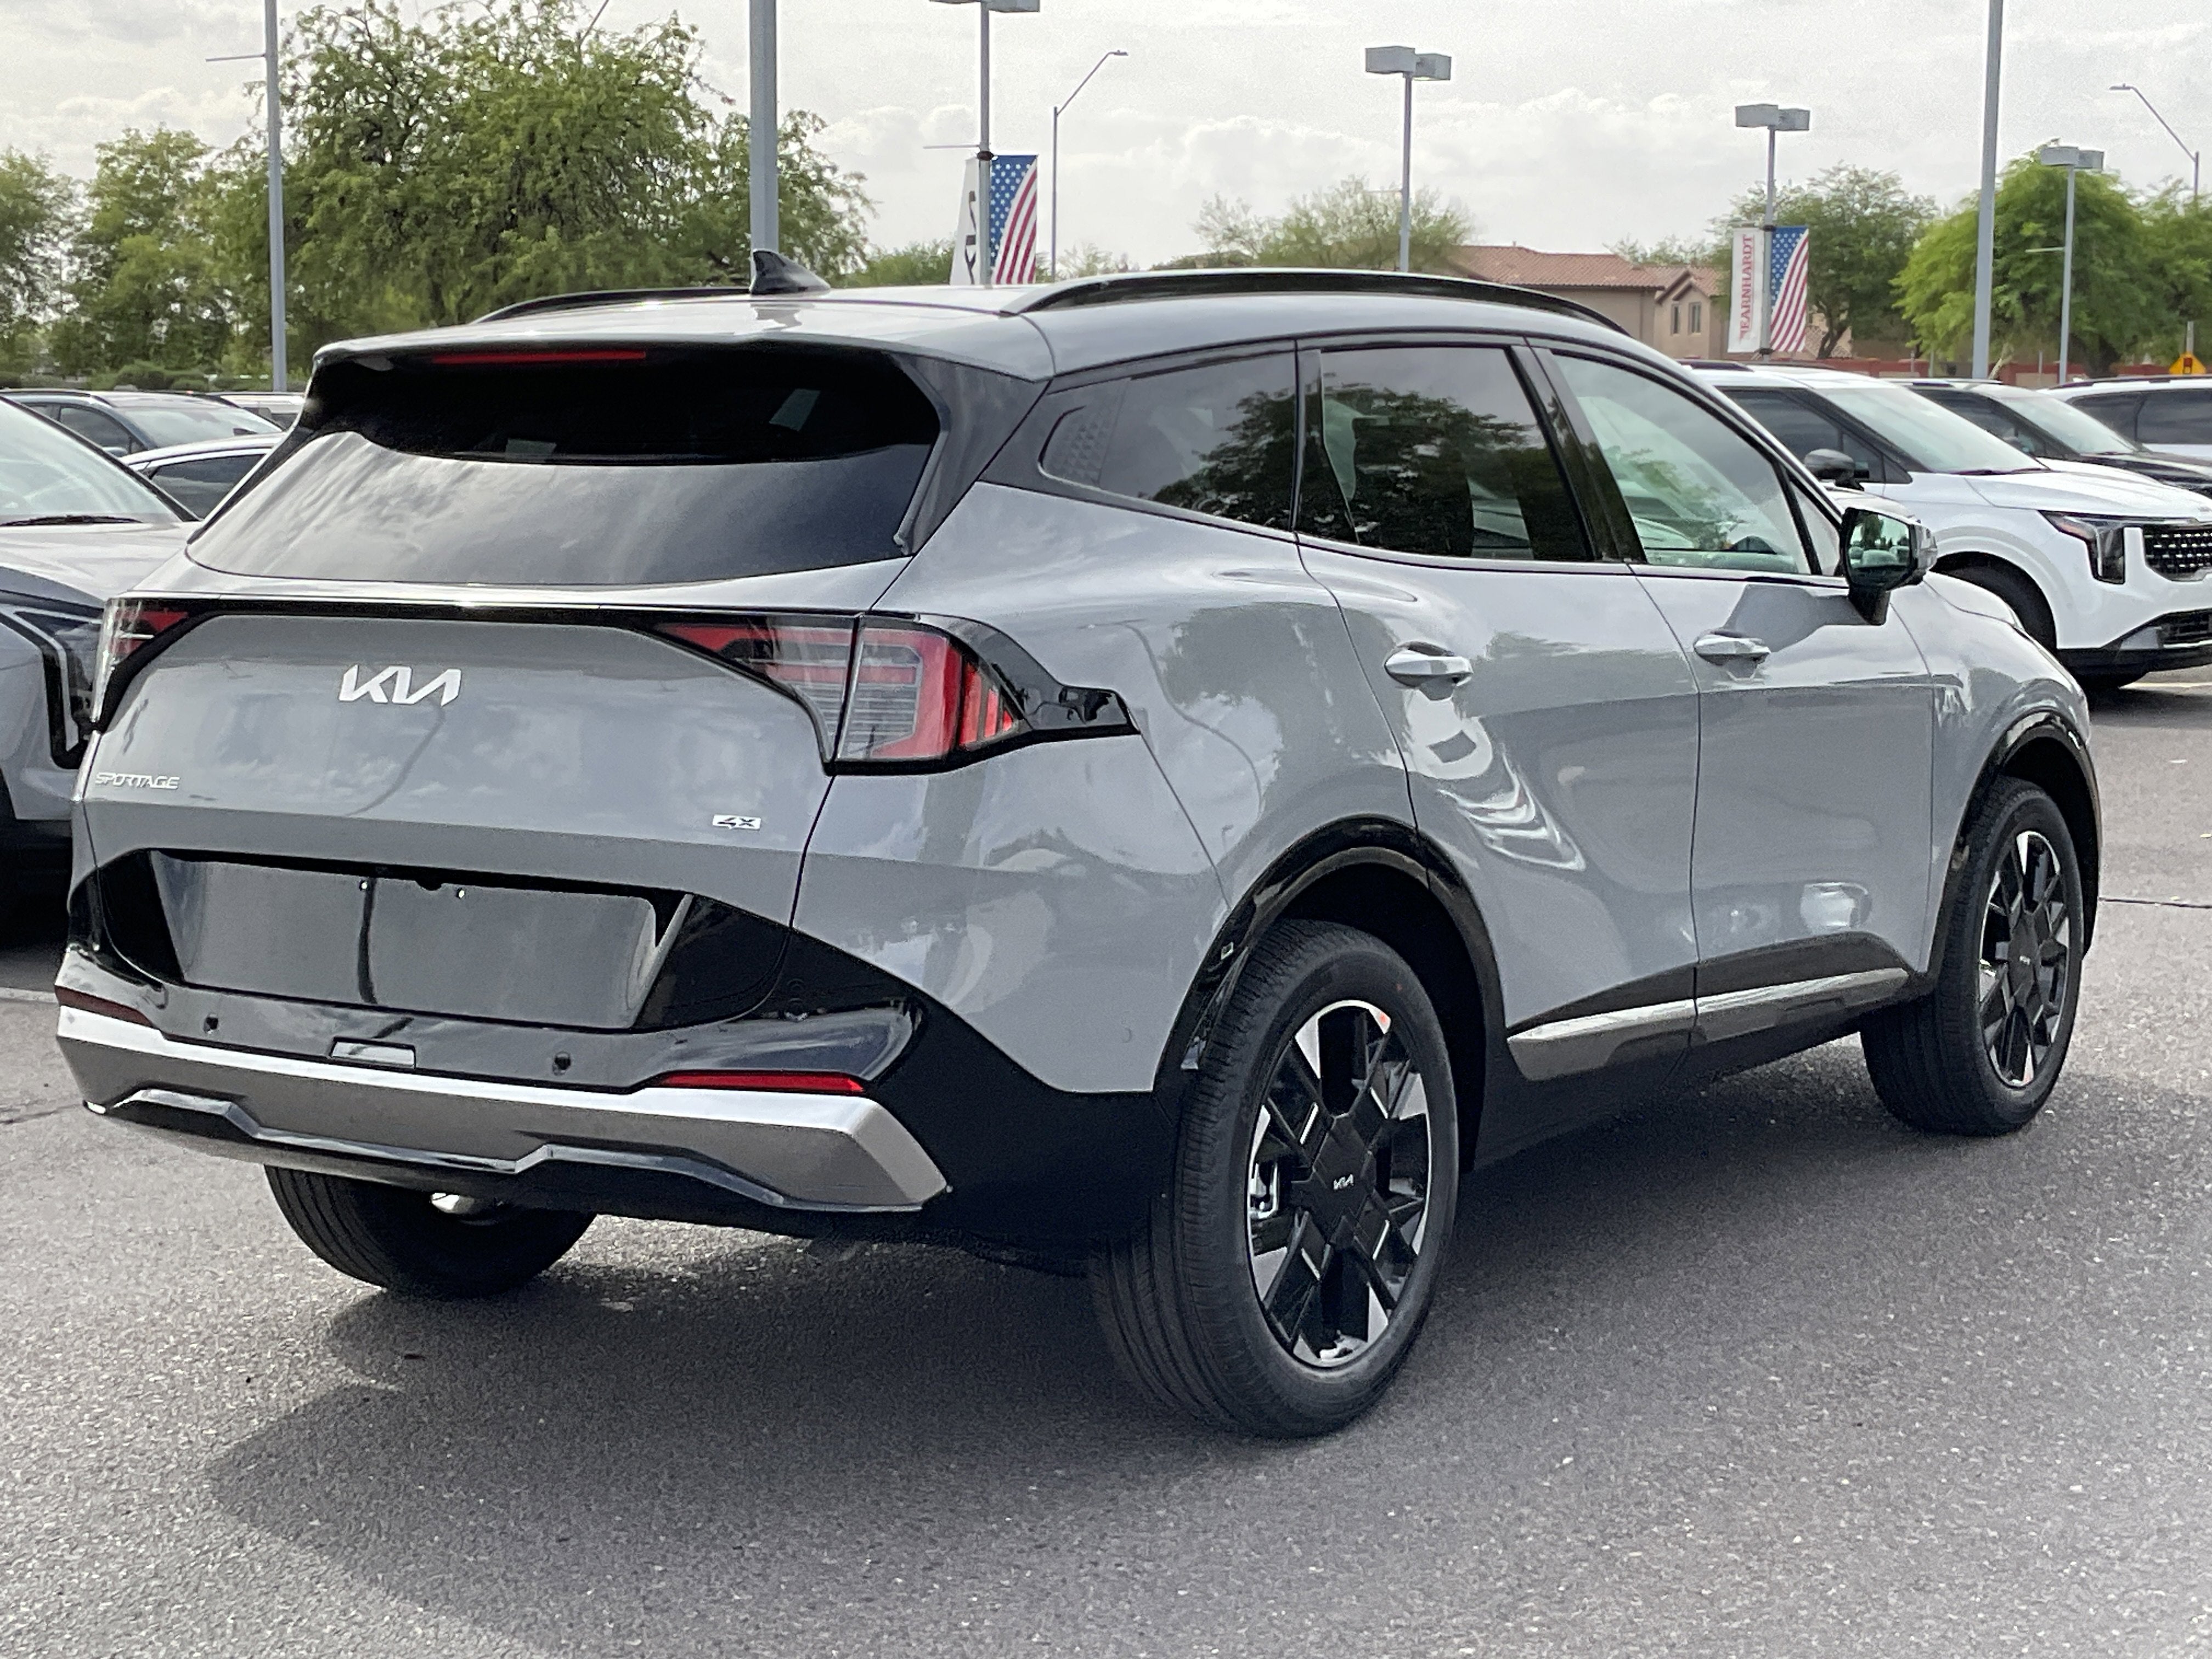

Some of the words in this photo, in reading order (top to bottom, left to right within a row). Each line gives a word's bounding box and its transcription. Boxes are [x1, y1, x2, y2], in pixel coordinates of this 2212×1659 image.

[1739, 234, 1754, 336] EARNHARDT
[338, 664, 462, 707] KIA
[95, 772, 180, 790] SPORTAGE
